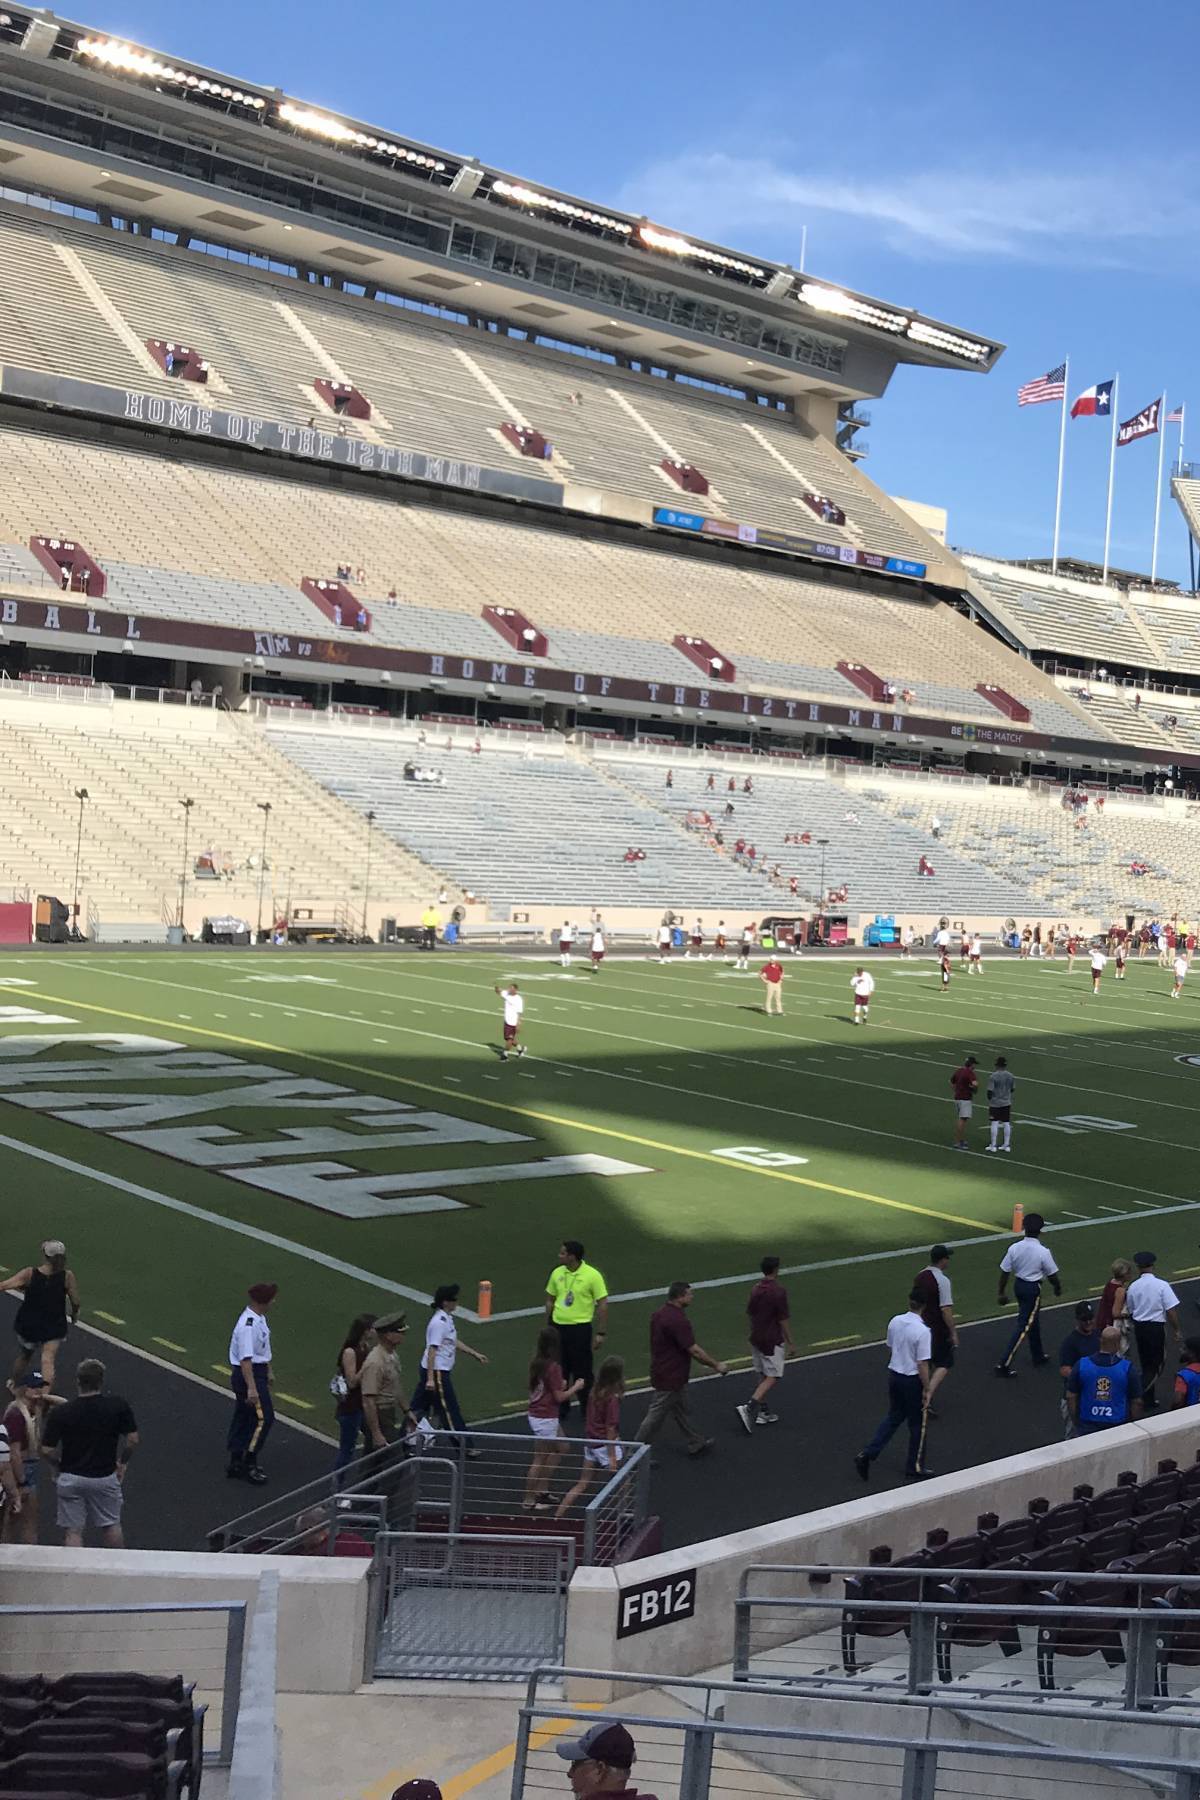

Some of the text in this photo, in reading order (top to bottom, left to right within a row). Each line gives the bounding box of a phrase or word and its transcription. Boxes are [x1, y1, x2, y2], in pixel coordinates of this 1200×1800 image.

[125, 391, 480, 489] HOME OF THE 12TH MAN
[431, 655, 903, 731] HOME OF THE 12TH MAN
[951, 725, 1021, 744] BE THE MATCH
[1014, 1114, 1139, 1134] 10
[709, 1146, 810, 1167] G
[1091, 1406, 1113, 1417] 072
[622, 1579, 691, 1628] FB12
